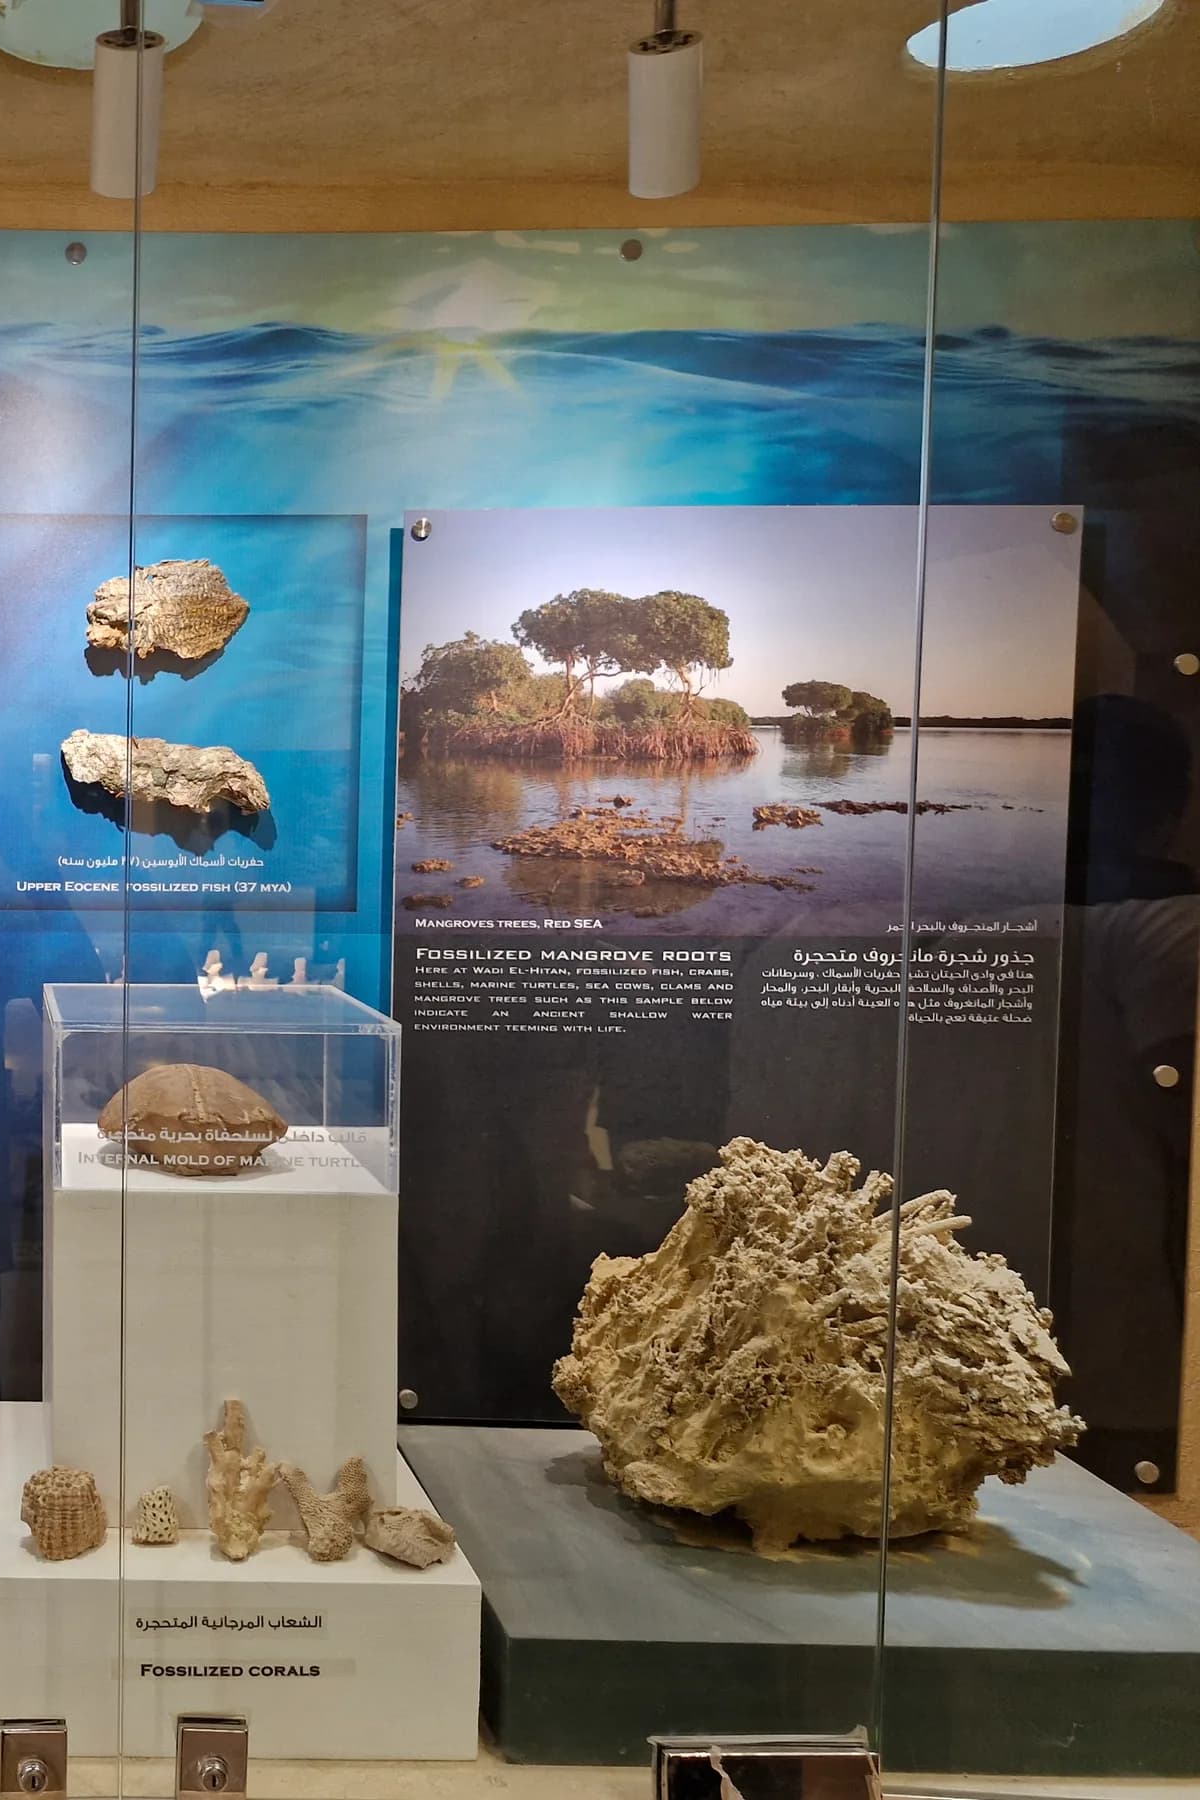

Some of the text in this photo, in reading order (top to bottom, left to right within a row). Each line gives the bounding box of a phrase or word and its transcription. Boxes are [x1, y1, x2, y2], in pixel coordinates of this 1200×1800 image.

[86, 855, 118, 869] مليون
[227, 856, 264, 868] حفريات
[16, 880, 61, 892] UPPER
[64, 881, 119, 892] EOCENE
[202, 882, 231, 893] FISH
[234, 881, 257, 894] (37
[260, 882, 291, 894] MYA)
[415, 918, 603, 930] MANGROVES TREES, RED SEA
[416, 948, 732, 962] FOSSILIZED MANGROVE ROOTS
[793, 948, 1035, 968] جذور شجرة متحجرة
[415, 966, 734, 978] HERE AT WADI EL-HITAN, FOSSILIZED FISH, CRABS,
[761, 967, 815, 980] وسرطانات
[863, 968, 900, 980] حفريات
[932, 968, 969, 981] الحيتان
[1016, 969, 1034, 979] هنا
[414, 980, 734, 991] SHELLS, MARINE TURTLES, SEA COWS, CLAMS AND
[760, 982, 797, 995] والمحار
[864, 982, 901, 995] البحرية
[1007, 983, 1034, 996] البحر
[414, 995, 734, 1005] MANGROVE TREES SUCH AS THIS SAMPLE BELOW
[760, 997, 783, 1008] مياه
[858, 997, 891, 1008] العينة
[918, 997, 940, 1010] مثل
[414, 1009, 733, 1019] INDICATE AN ANCIENT SHALLOW WATER
[908, 1012, 943, 1023] بالحياة
[968, 1013, 999, 1023] عتيقة
[1002, 1012, 1032, 1023] ضحلة
[414, 1023, 627, 1034] ENVIRONMENT TEEMING WITH LIFE.
[159, 1127, 202, 1143] بحرية
[164, 1154, 209, 1166] MOLD
[213, 1155, 236, 1166] OF
[135, 1615, 322, 1632] الشعاب المرجانية المتحجرة
[140, 1663, 321, 1677] FOSSILIZED CORALS
